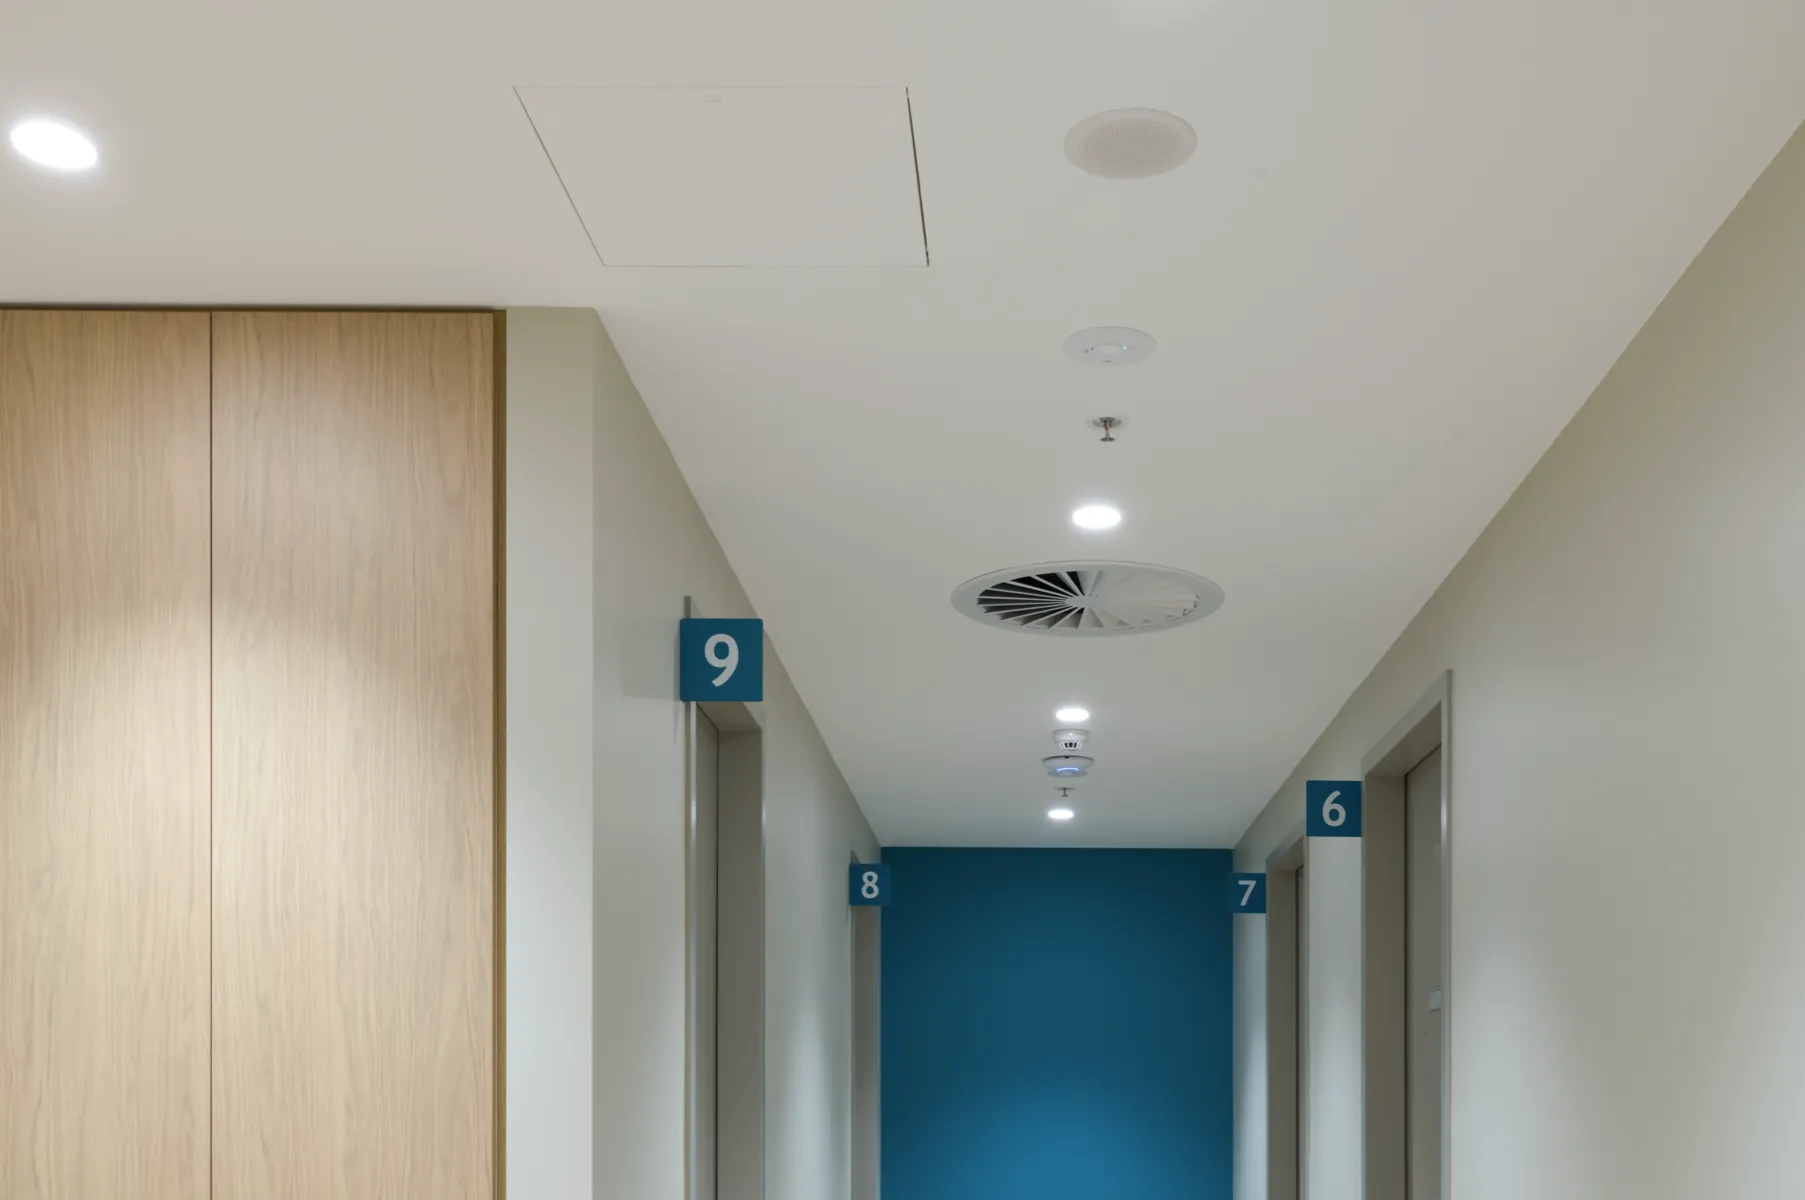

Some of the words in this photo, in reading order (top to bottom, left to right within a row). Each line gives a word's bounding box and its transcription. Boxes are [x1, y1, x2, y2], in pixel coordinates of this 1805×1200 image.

[704, 633, 739, 687] 9
[1322, 790, 1346, 827] 6
[861, 871, 879, 899] 8
[1238, 880, 1256, 906] 7
